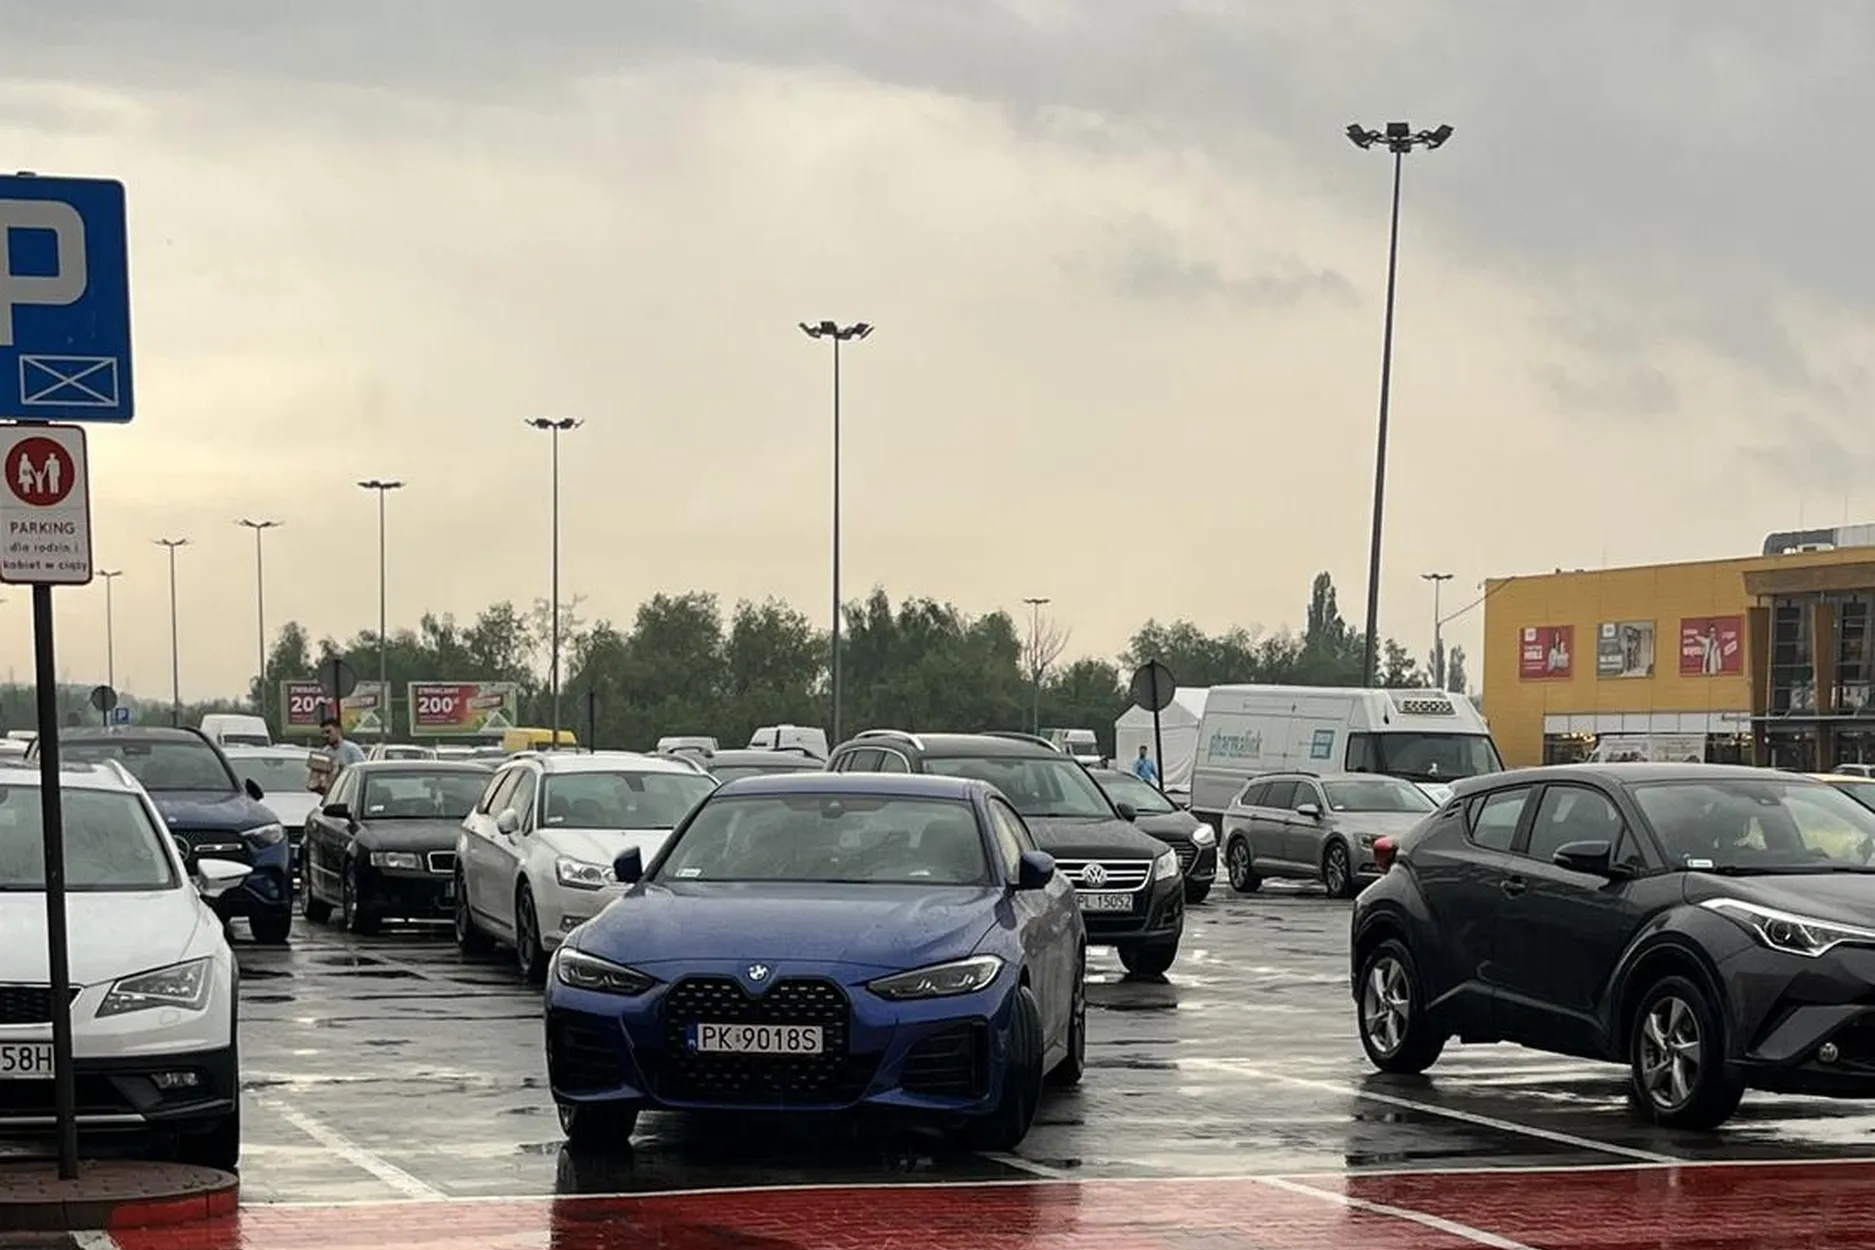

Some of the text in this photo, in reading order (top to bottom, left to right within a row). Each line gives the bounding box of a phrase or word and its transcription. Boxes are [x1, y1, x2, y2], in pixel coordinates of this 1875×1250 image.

[0, 199, 87, 345] P
[10, 521, 75, 534] PARKING
[10, 541, 29, 552] dla
[34, 542, 70, 552] rodzin
[3, 560, 40, 569] kobiet
[702, 1026, 732, 1049] PK
[742, 1027, 816, 1051] 9018S
[2, 1046, 52, 1071] 58H
